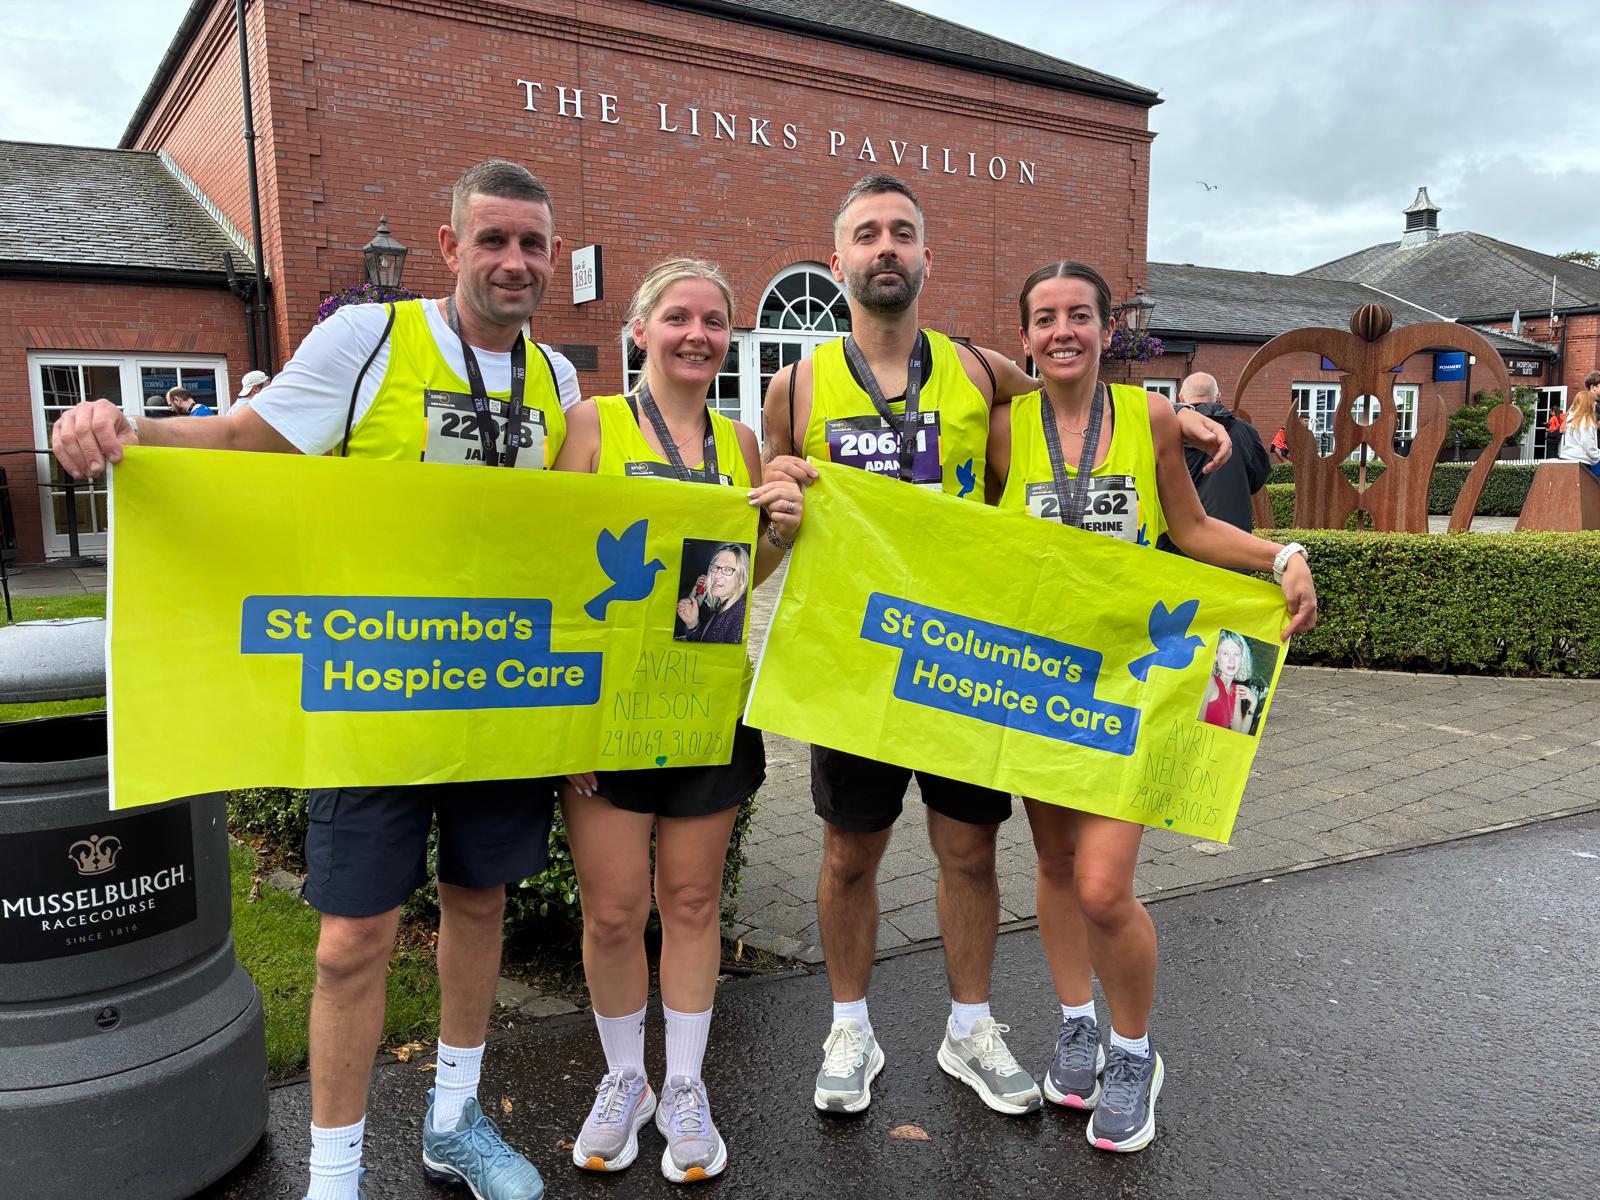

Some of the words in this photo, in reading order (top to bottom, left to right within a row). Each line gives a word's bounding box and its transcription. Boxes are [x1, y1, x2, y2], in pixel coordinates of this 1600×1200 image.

[516, 78, 620, 124] THE
[657, 102, 798, 149] LINKS
[828, 129, 1036, 184] PAVILION
[574, 267, 593, 288] 1816
[465, 447, 506, 464] JAE
[840, 429, 927, 456] 2061
[1041, 492, 1128, 518] 2262
[1081, 521, 1123, 532] ERINE
[266, 608, 312, 640] St
[323, 608, 533, 641] Columba's
[880, 608, 915, 639] St
[921, 619, 1083, 683] Columba's
[323, 659, 487, 698] Hospice
[496, 659, 585, 688] Care
[632, 650, 705, 684] AVRIL
[614, 691, 710, 721] NELSON
[912, 660, 1037, 714] Hospice
[1046, 695, 1122, 736] Care
[1164, 719, 1218, 763] AVRIL
[1144, 752, 1221, 799] NELSON
[2, 864, 185, 918] MUSSELBURGH
[42, 898, 156, 931] RACECOURSE
[65, 932, 102, 945] SINCE
[110, 924, 139, 937] 1816
